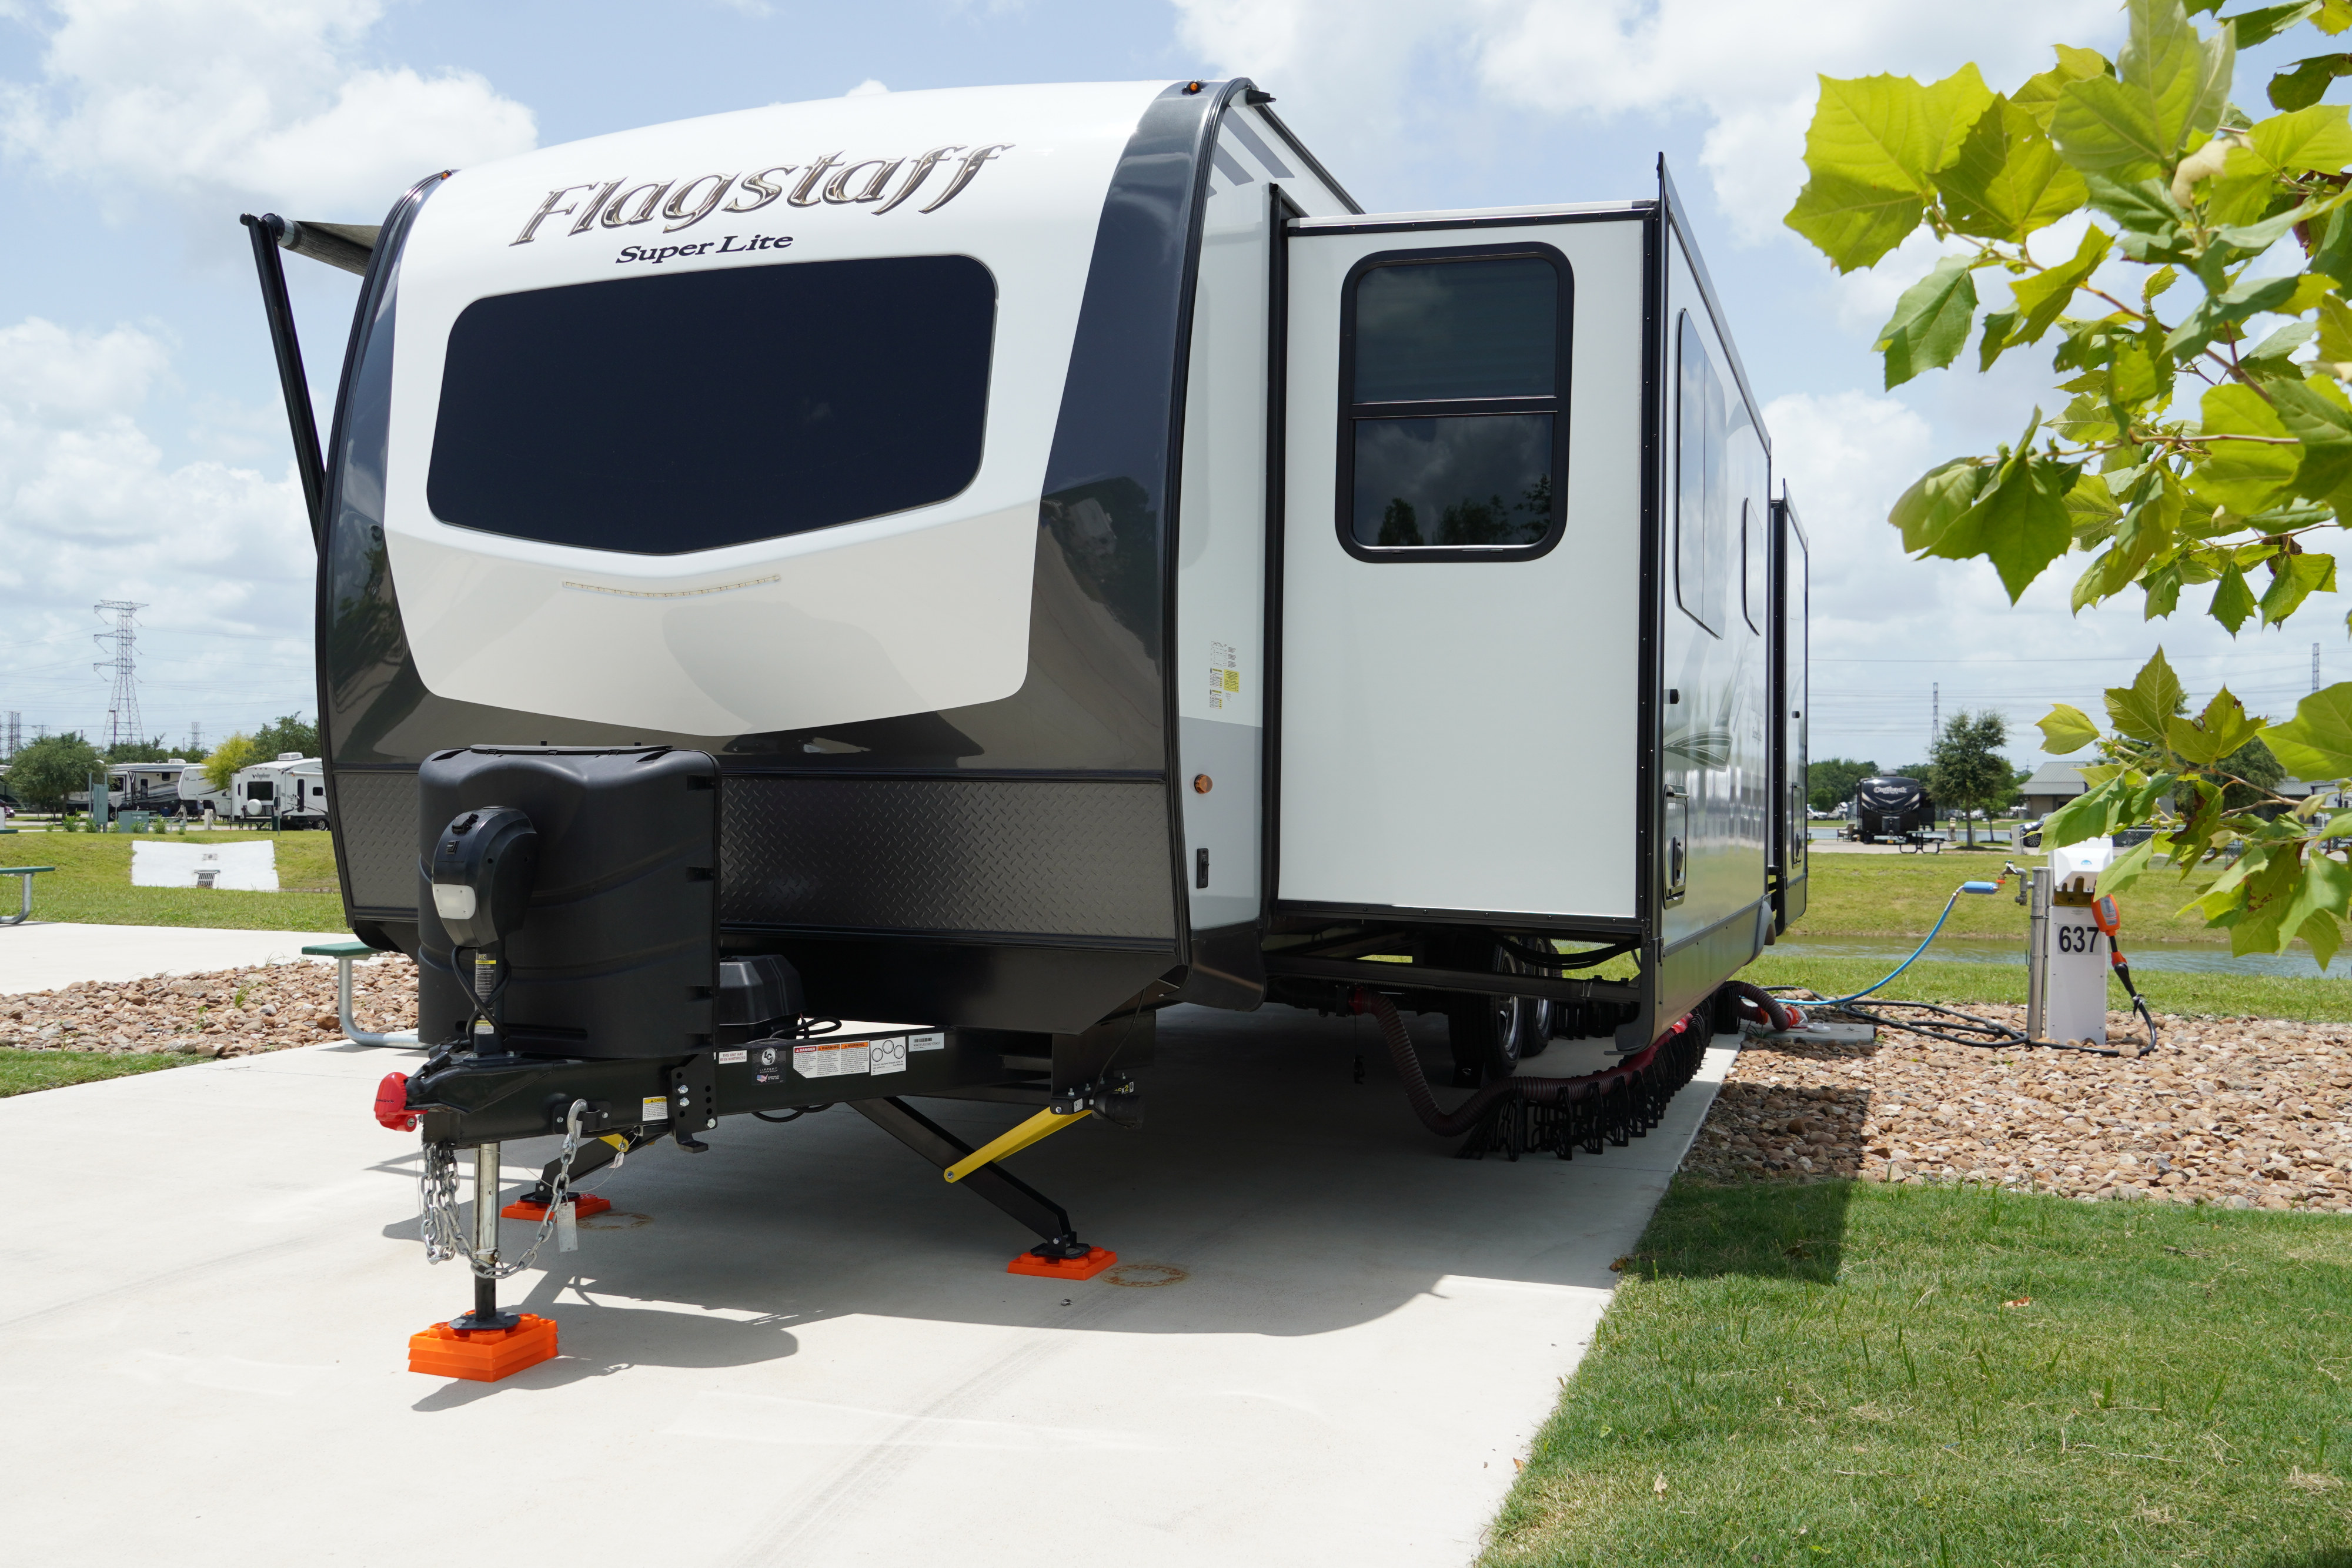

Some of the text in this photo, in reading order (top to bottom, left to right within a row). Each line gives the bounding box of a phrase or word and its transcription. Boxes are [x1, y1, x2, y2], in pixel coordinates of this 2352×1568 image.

[509, 143, 1016, 246] Flagstaff
[615, 234, 794, 264] Super Lite
[2059, 926, 2099, 952] 637
